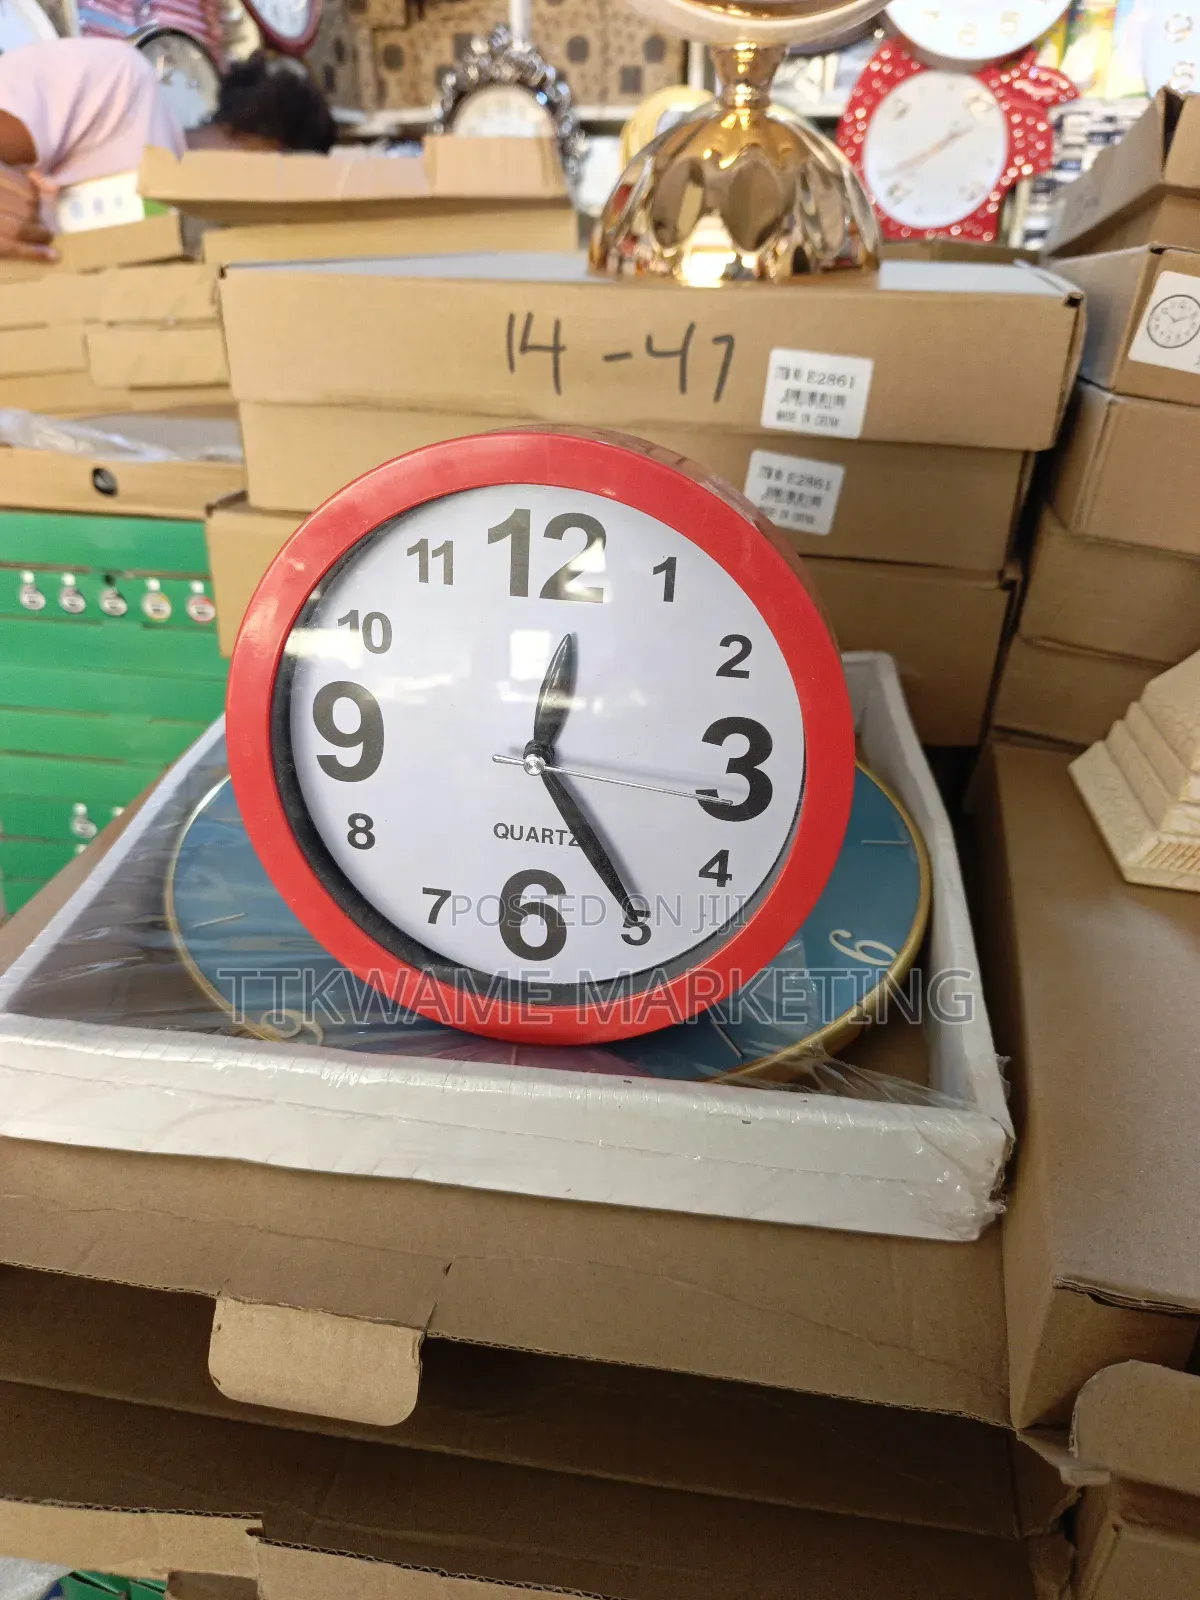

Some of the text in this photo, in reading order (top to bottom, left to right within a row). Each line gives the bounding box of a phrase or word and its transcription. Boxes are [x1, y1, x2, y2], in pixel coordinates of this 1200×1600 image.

[806, 369, 856, 390] E2861
[406, 538, 454, 586] 11
[487, 508, 607, 604] 12
[652, 556, 679, 603] 1
[716, 634, 752, 679] 2
[311, 681, 385, 783] 9
[695, 716, 774, 822] 3
[346, 813, 376, 850] 8
[698, 848, 734, 889] 4
[421, 887, 453, 925] 7
[499, 868, 568, 962] 6
[620, 908, 652, 947] 5
